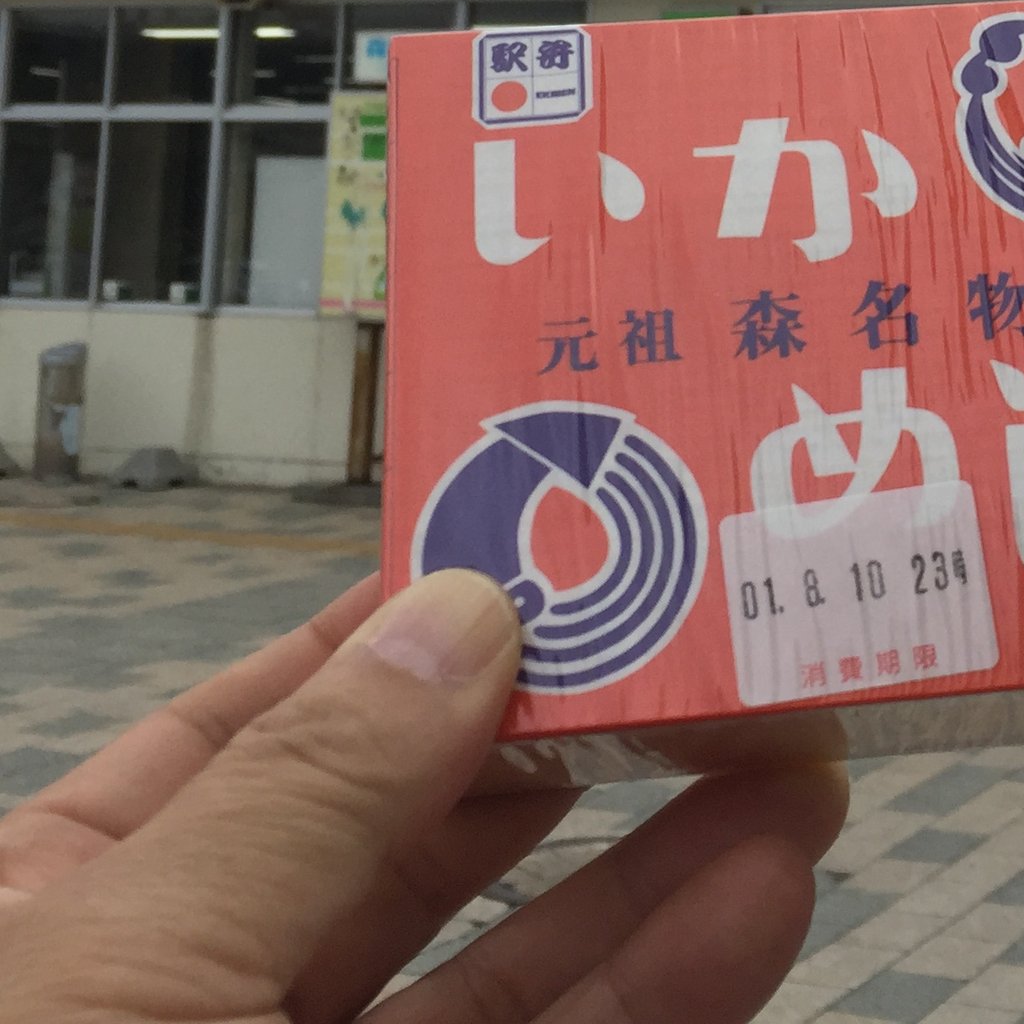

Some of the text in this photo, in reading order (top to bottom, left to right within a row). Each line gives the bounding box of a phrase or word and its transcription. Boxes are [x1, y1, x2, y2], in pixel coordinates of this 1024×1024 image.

[850, 559, 886, 602] 10
[801, 642, 938, 689] 消費期限
